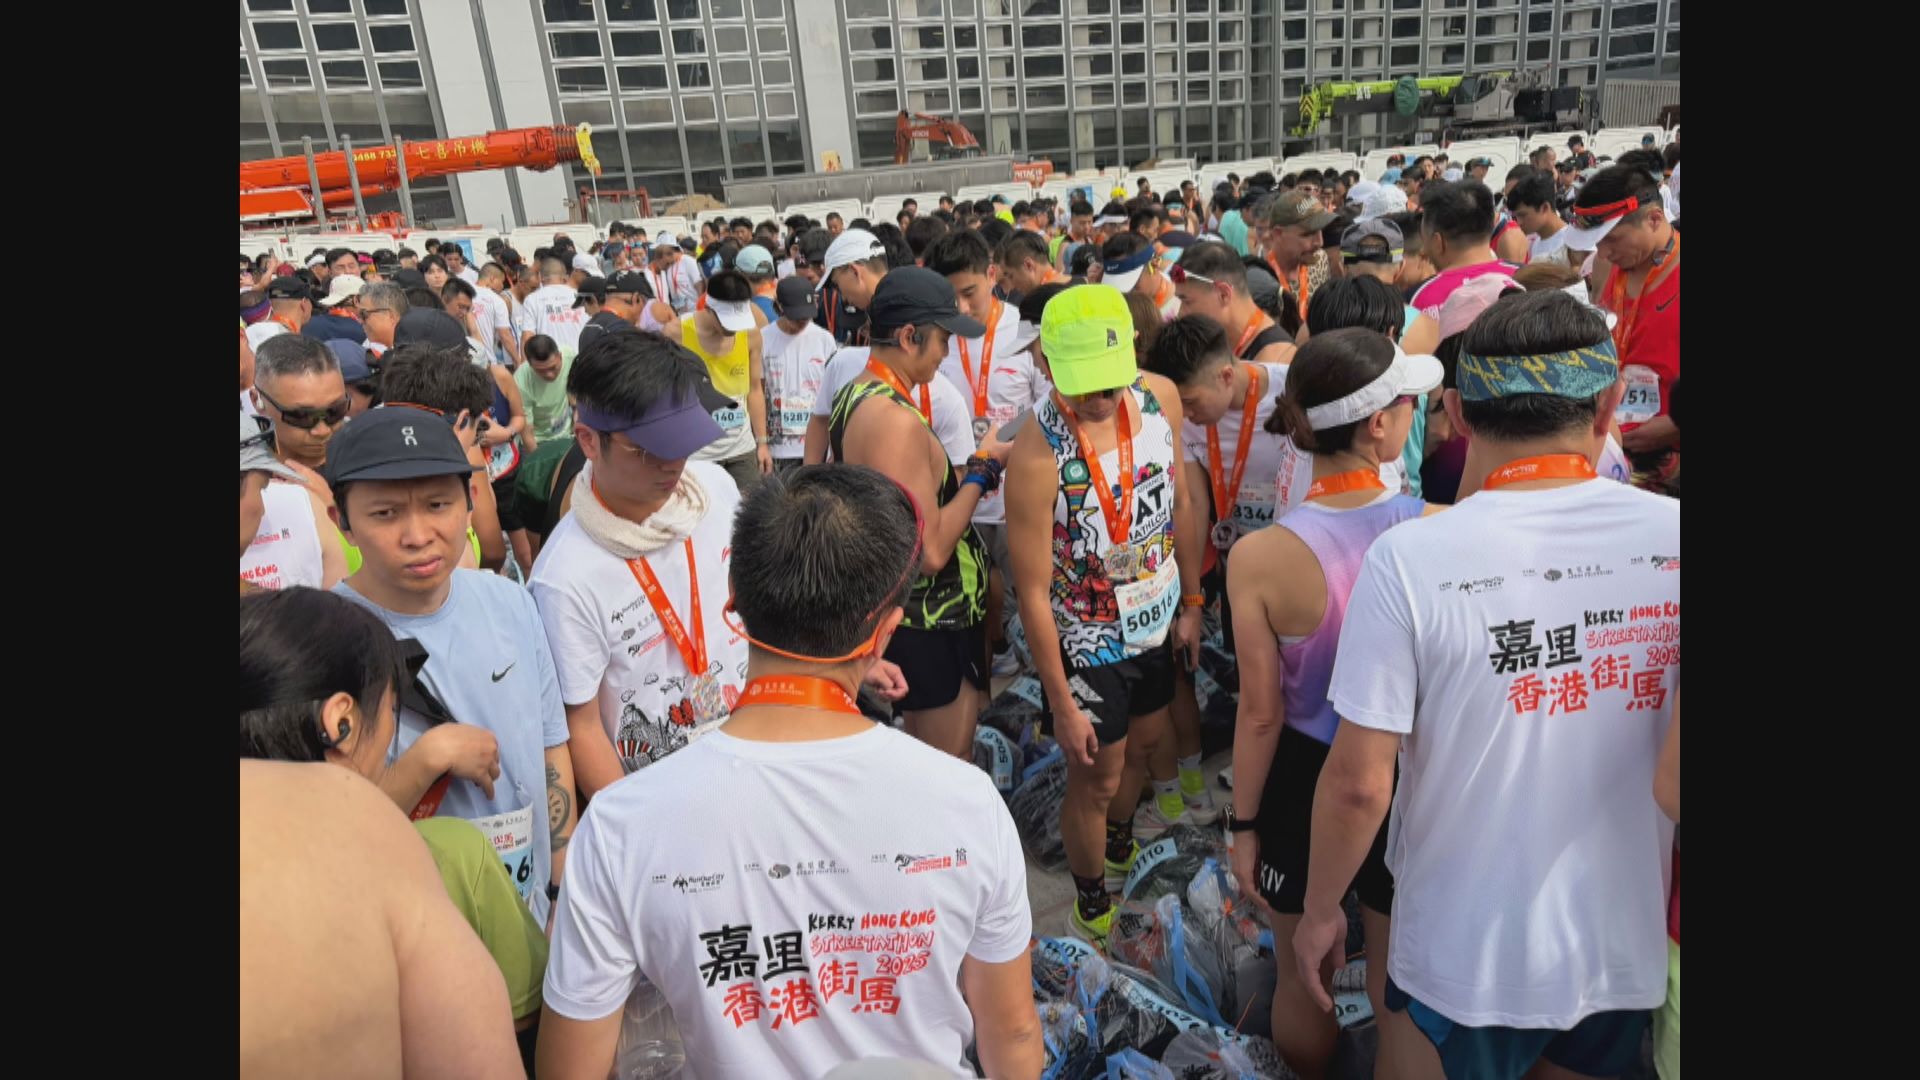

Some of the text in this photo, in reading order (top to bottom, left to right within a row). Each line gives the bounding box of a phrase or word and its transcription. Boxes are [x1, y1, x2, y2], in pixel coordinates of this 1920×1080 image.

[1127, 591, 1172, 633] 50816
[1584, 600, 1680, 628] KERRY HONG KO
[1488, 619, 1582, 675] 嘉里
[1646, 645, 1680, 668] 202
[1507, 654, 1668, 716] 香港街馬
[808, 908, 936, 933] KERRY HONG KONG
[699, 924, 809, 987] 嘉里
[810, 930, 935, 957] STREETATHON
[875, 951, 930, 977] 2025
[723, 959, 902, 1030] 香港街馬
